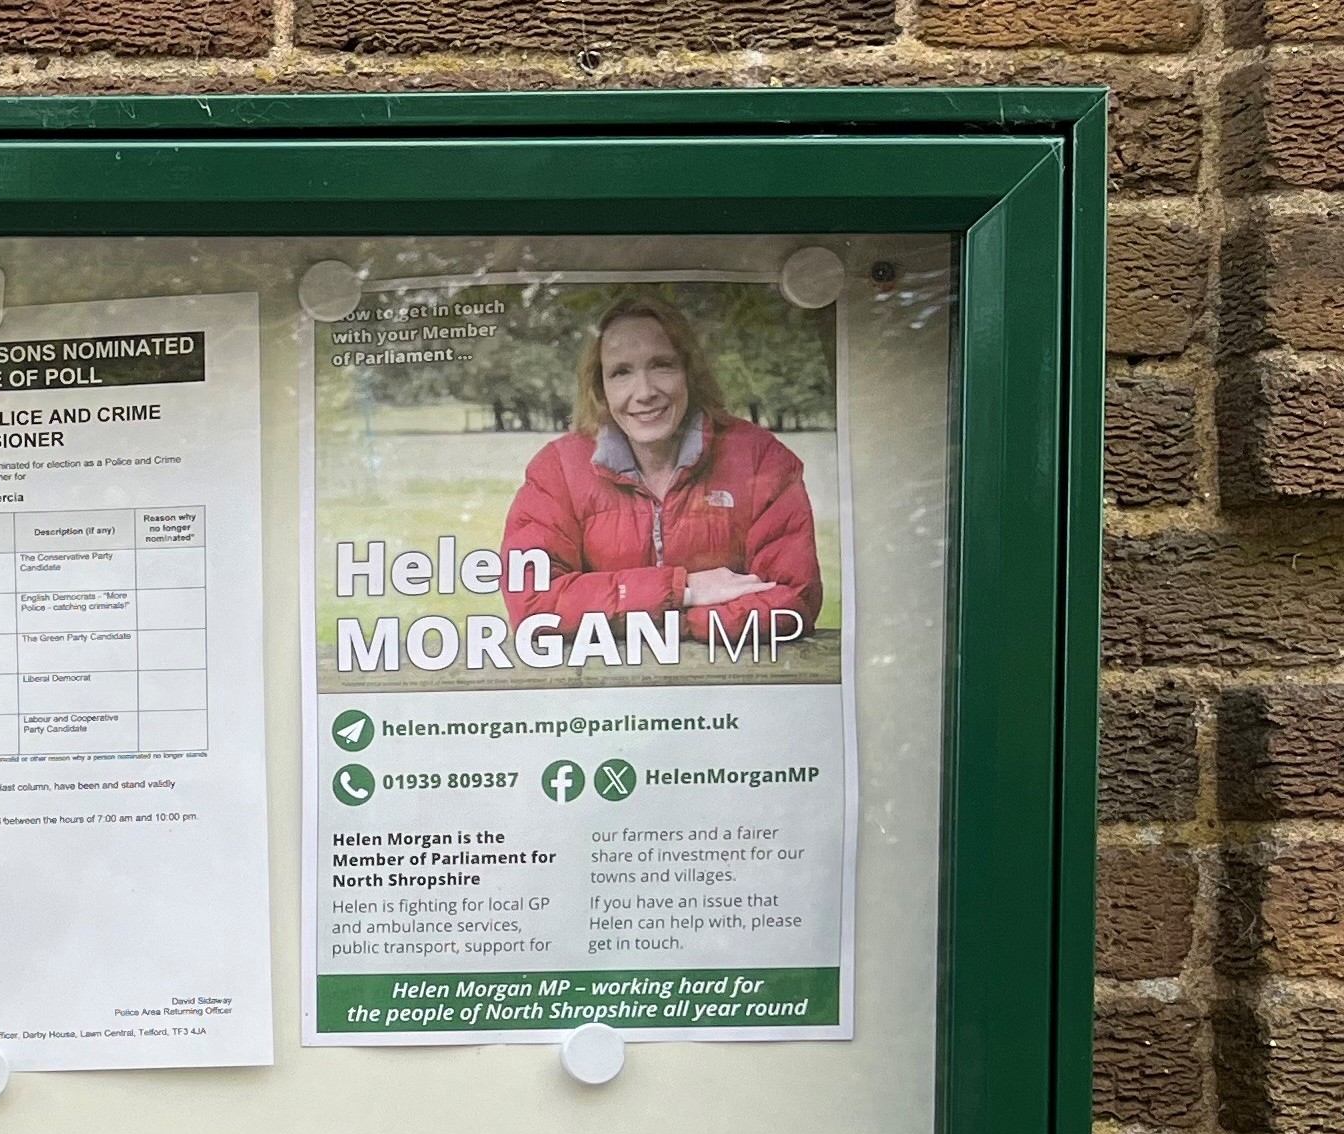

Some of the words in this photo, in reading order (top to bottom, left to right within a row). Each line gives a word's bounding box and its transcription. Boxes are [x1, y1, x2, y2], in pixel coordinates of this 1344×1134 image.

[336, 312, 370, 322] ow
[376, 308, 393, 320] to
[398, 307, 428, 322] get
[432, 305, 449, 317] in
[454, 300, 504, 316] touch
[332, 327, 372, 346] with
[377, 327, 417, 346] your
[423, 323, 497, 340] Member
[63, 337, 194, 360] NOMINATED
[333, 352, 350, 365] of
[356, 348, 453, 365] Parliament
[9, 369, 38, 387] OF
[45, 367, 103, 385] POLL
[48, 408, 91, 424] AND
[97, 404, 161, 422] CRIME
[335, 536, 552, 598] Helen
[336, 609, 681, 673] MORGAN
[708, 609, 805, 664] MP
[382, 712, 739, 738] helen.morgan.mp@parliament.uk
[383, 773, 441, 790] 01939
[447, 772, 518, 788] 809387
[646, 767, 819, 788] HelenMorganMP
[333, 833, 382, 846] Helen
[388, 832, 452, 849] Morgan
[458, 831, 471, 844] is
[476, 830, 505, 844] the
[592, 831, 618, 842] our
[622, 827, 684, 842] farmers
[688, 826, 718, 841] and
[723, 829, 732, 840] a
[737, 826, 779, 840] fairer
[333, 853, 405, 867] Member
[409, 852, 427, 865] of
[432, 851, 527, 865] Parliament
[531, 850, 556, 864] for
[591, 849, 633, 863] share
[637, 848, 654, 862] of
[658, 849, 746, 862] investment
[750, 846, 773, 860] for
[777, 849, 805, 860] our
[333, 873, 383, 887] North
[388, 872, 480, 890] Shropshire
[590, 872, 636, 884] towns
[640, 868, 670, 883] and
[674, 868, 736, 886] villages.
[333, 899, 377, 914] Helen
[382, 899, 394, 913] is
[399, 898, 458, 916] fighting
[462, 897, 484, 912] for
[489, 897, 523, 911] local
[528, 897, 550, 910] GP
[590, 895, 601, 909] If
[603, 898, 631, 913] you
[637, 895, 673, 909] have
[678, 897, 697, 908] an
[703, 895, 743, 908] issue
[747, 893, 779, 907] that
[332, 920, 361, 934] and
[366, 919, 452, 934] ambulance
[457, 921, 522, 934] services,
[589, 916, 633, 930] Helen
[638, 918, 665, 929] can
[670, 915, 704, 933] help
[708, 914, 746, 929] with,
[751, 914, 802, 932] please
[332, 940, 379, 958] public
[384, 941, 459, 957] transport,
[465, 940, 525, 956] support
[529, 937, 552, 952] for
[588, 938, 612, 954] get
[616, 937, 630, 950] in
[635, 936, 683, 950] touch.
[392, 981, 449, 998] Helen
[456, 981, 532, 1001] Morgan
[538, 980, 571, 996] MP
[592, 977, 674, 999] working
[678, 976, 729, 994] hard
[729, 976, 765, 998] for
[347, 1005, 381, 1022] the
[385, 1004, 454, 1026] people
[460, 1003, 483, 1025] of
[485, 1002, 543, 1020] North
[548, 1001, 658, 1022] Shropshire
[663, 1000, 690, 1017] all
[691, 1003, 741, 1021] year
[746, 998, 809, 1016] round
